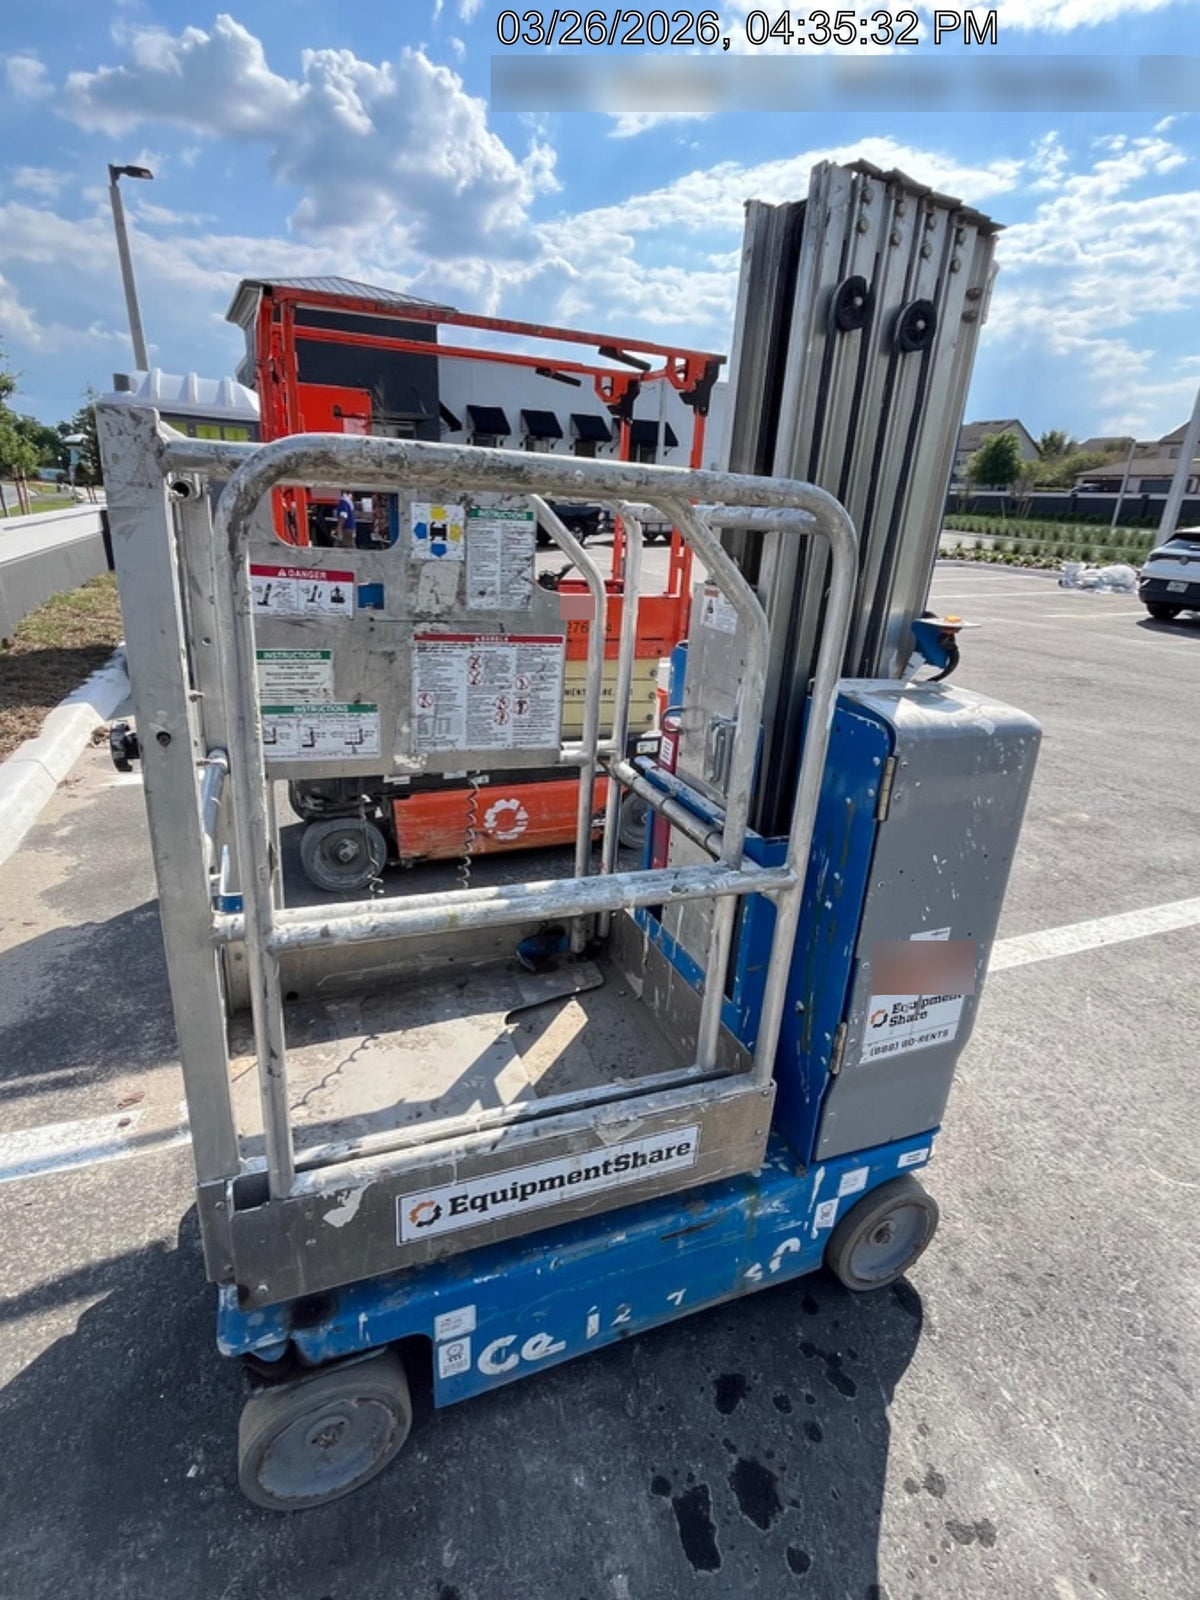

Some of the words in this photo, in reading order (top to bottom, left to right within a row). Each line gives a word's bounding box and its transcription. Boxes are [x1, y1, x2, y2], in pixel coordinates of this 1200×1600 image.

[287, 568, 327, 580] DANGER
[263, 651, 322, 659] INSTRUCTIONS
[293, 705, 349, 713] INSTRUCTIONS
[888, 1011, 928, 1025] Share
[447, 1141, 692, 1217] EquipmentShare
